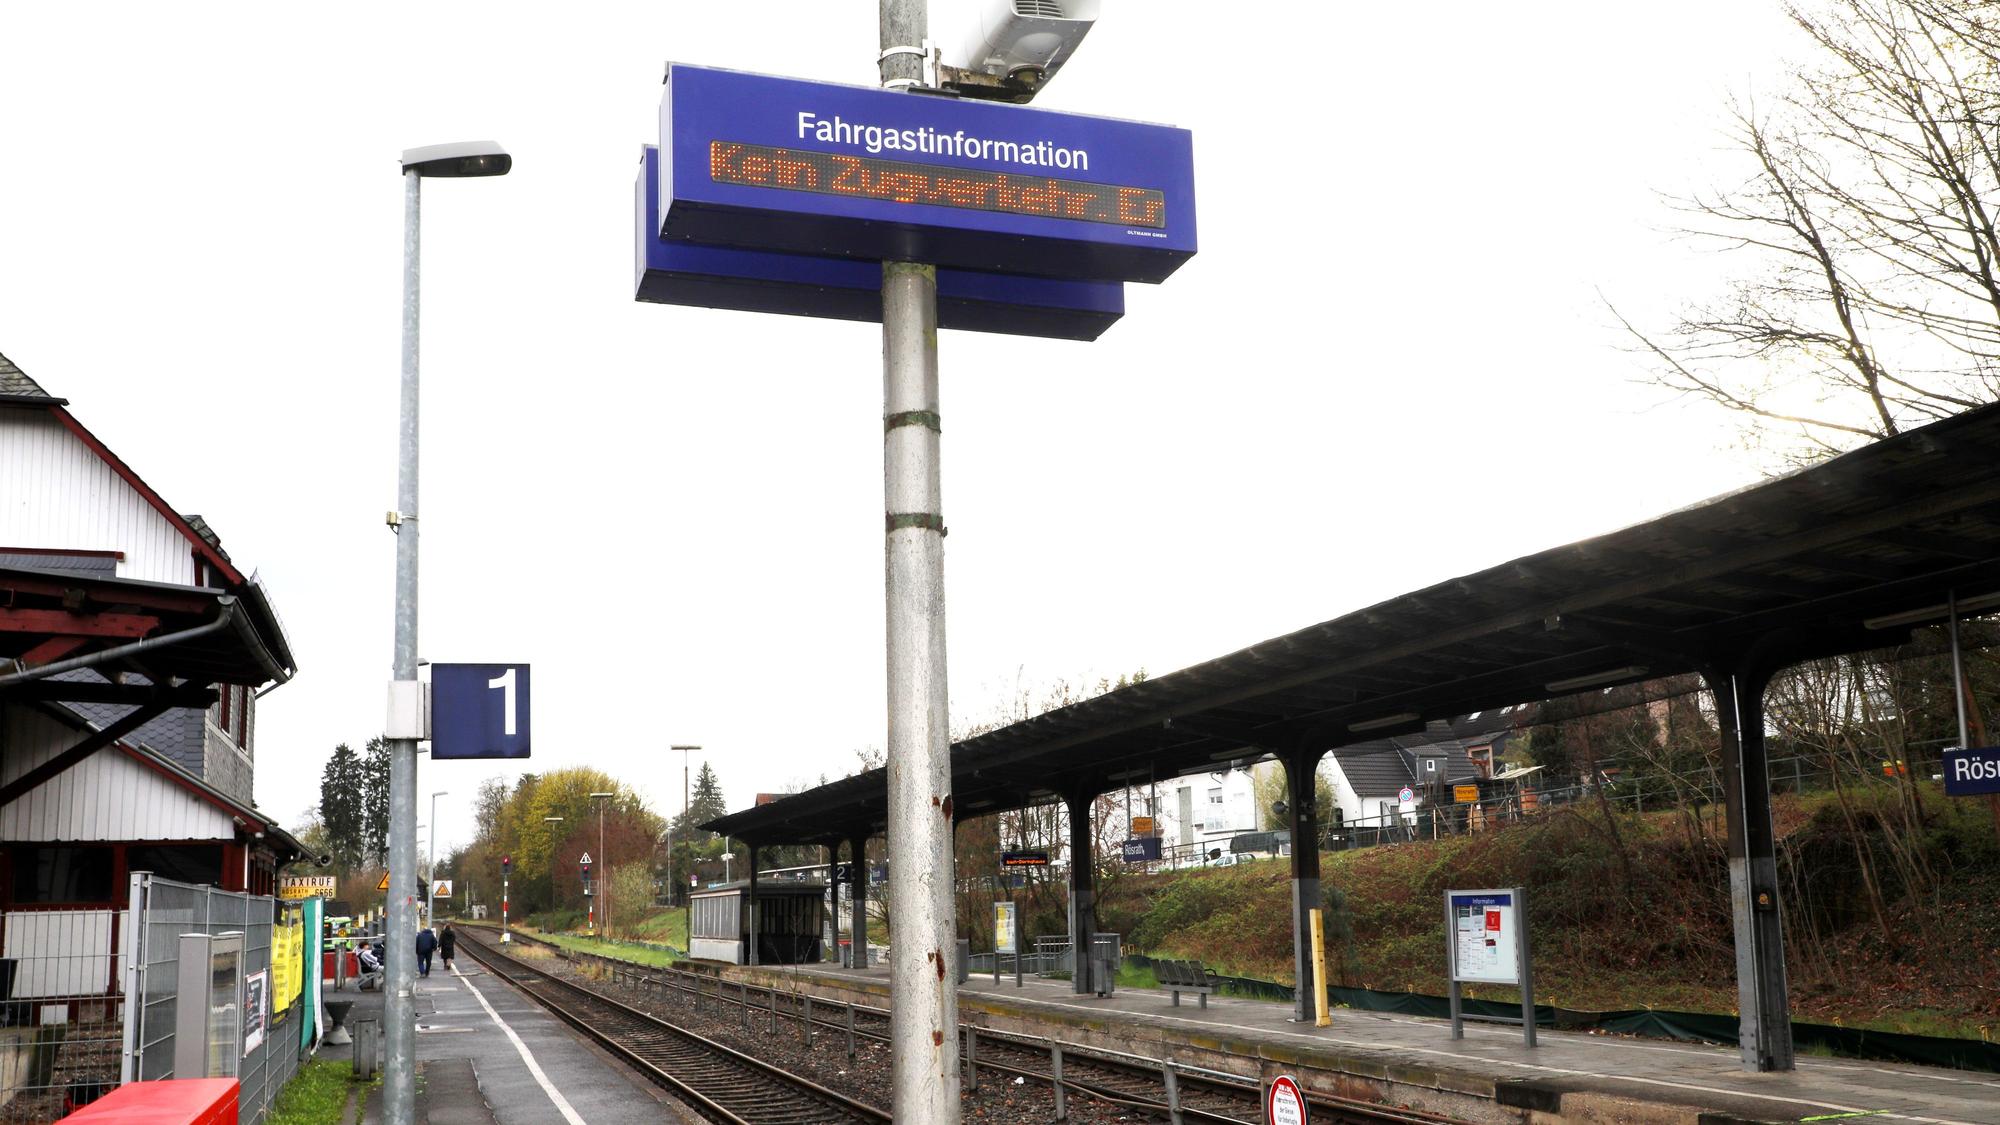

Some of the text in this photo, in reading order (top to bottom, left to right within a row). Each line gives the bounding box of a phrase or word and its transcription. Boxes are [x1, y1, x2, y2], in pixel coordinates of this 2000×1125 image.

[798, 111, 1089, 171] Fahrgastinformation
[711, 143, 1163, 223] Kein Zugverkehr. Er
[488, 668, 517, 735] 1
[284, 877, 332, 887] TAXIRUF
[837, 866, 846, 880] 2
